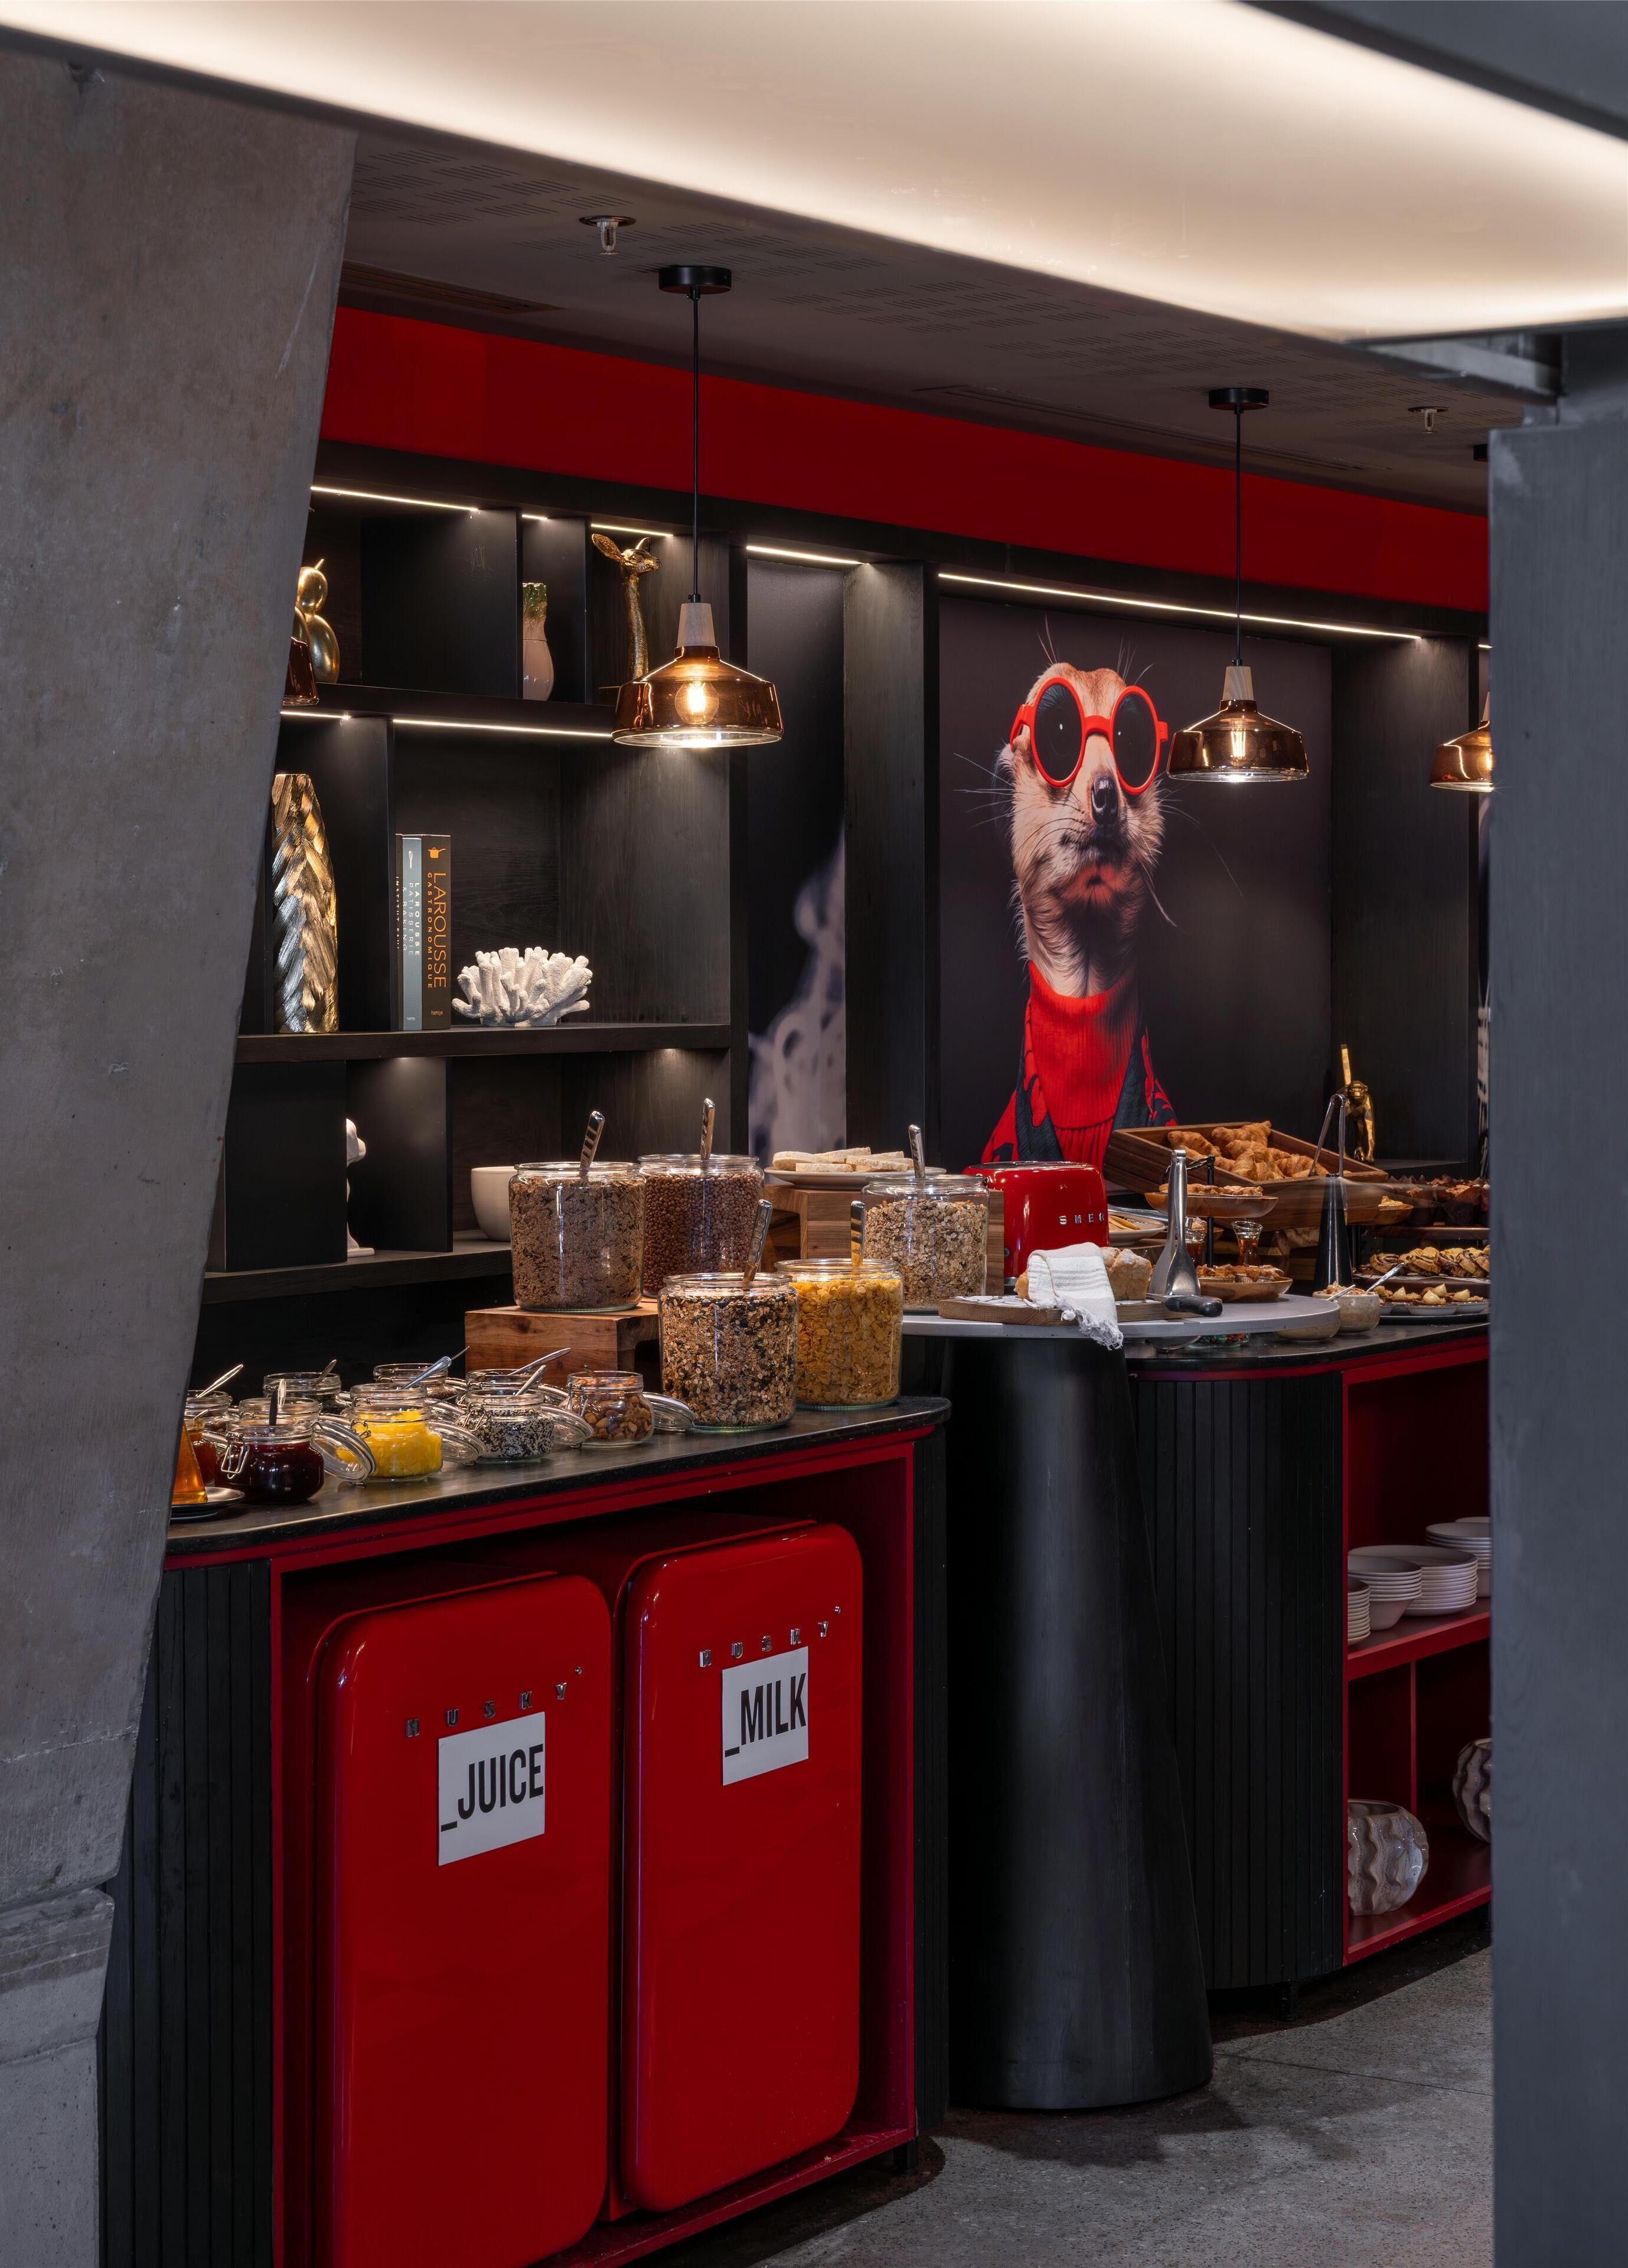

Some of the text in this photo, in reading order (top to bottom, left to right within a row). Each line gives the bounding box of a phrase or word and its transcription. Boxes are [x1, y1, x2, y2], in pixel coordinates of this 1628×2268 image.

[434, 872, 446, 988] LAROUSSE
[1059, 1213, 1104, 1225] SMEG
[699, 1620, 830, 1667] HUSKY
[406, 1682, 567, 1738] HUSKY
